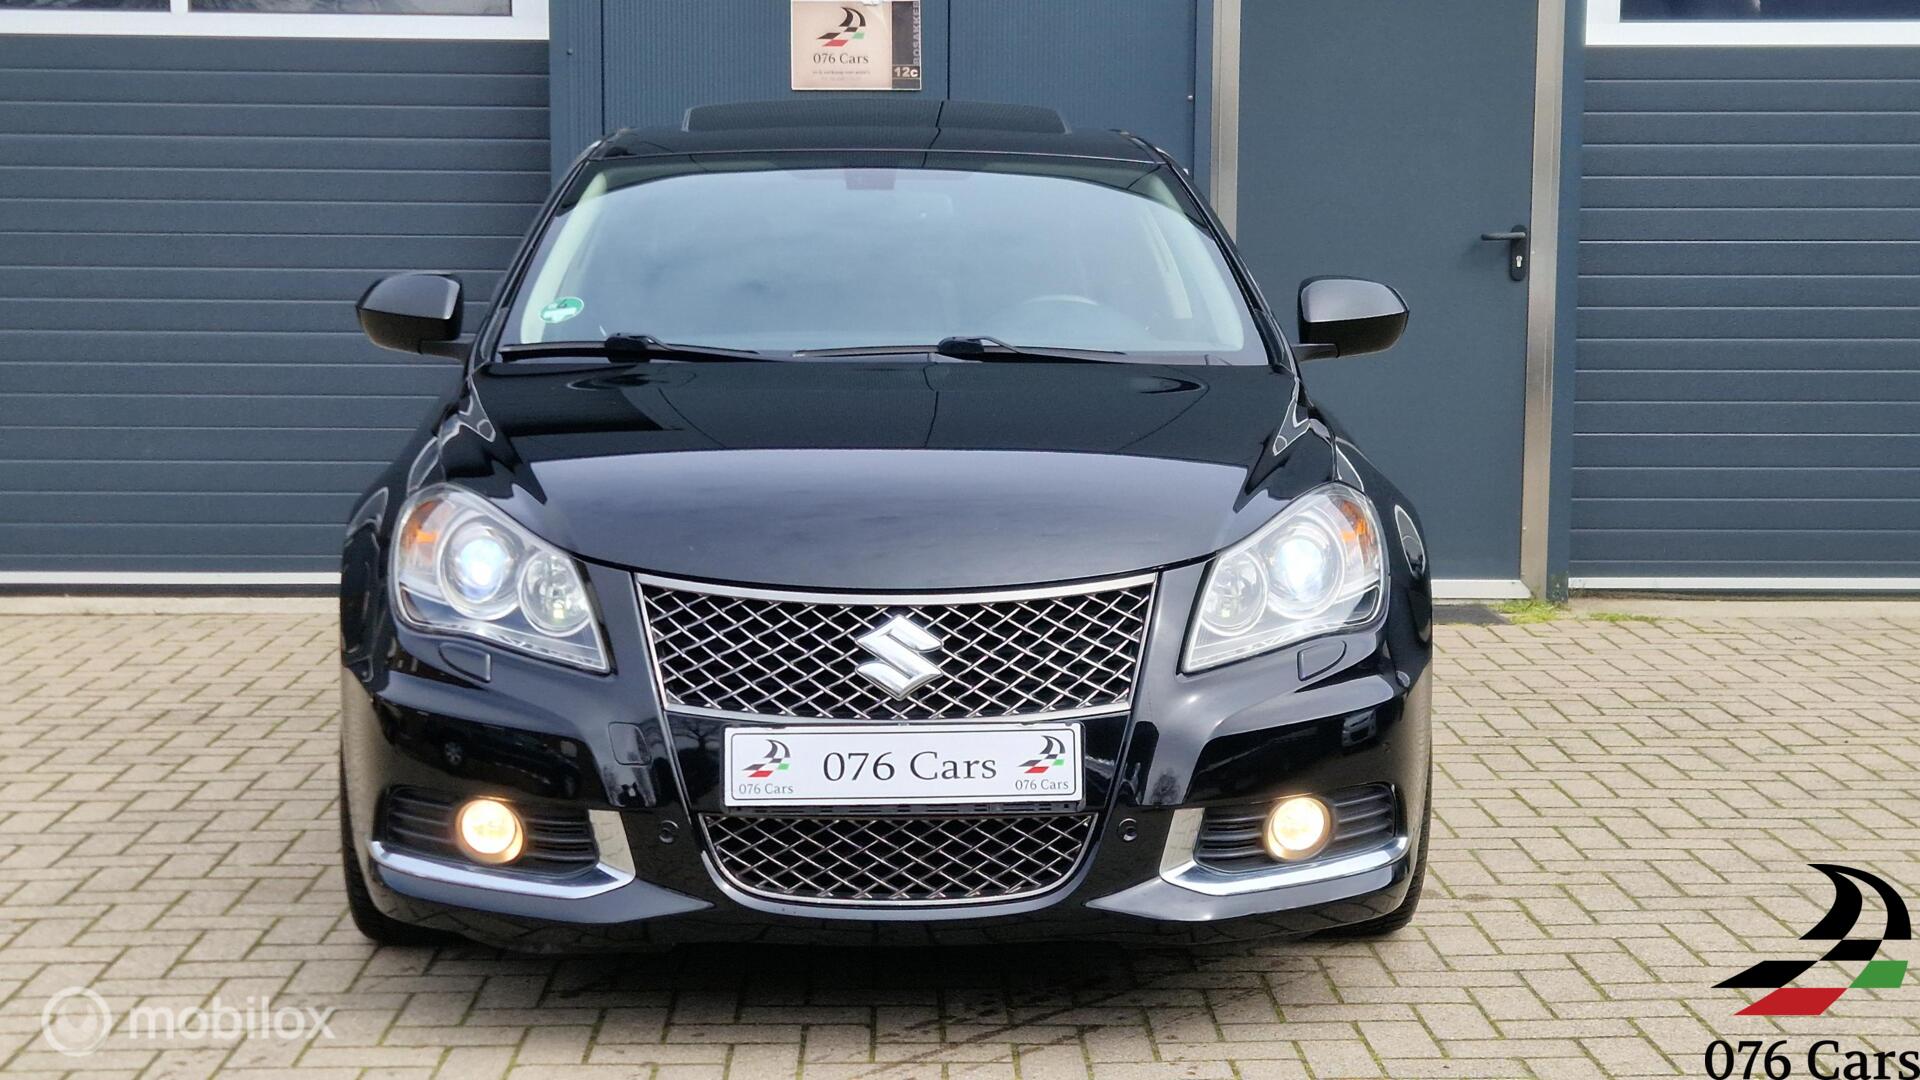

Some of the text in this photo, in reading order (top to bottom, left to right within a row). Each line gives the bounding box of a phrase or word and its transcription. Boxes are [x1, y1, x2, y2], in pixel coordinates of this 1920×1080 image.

[813, 53, 869, 65] 076 Cars
[894, 66, 918, 78] 12c
[822, 751, 998, 782] 076 Cars
[738, 783, 794, 795] 076 Cars
[1015, 779, 1069, 791] 076 Cars
